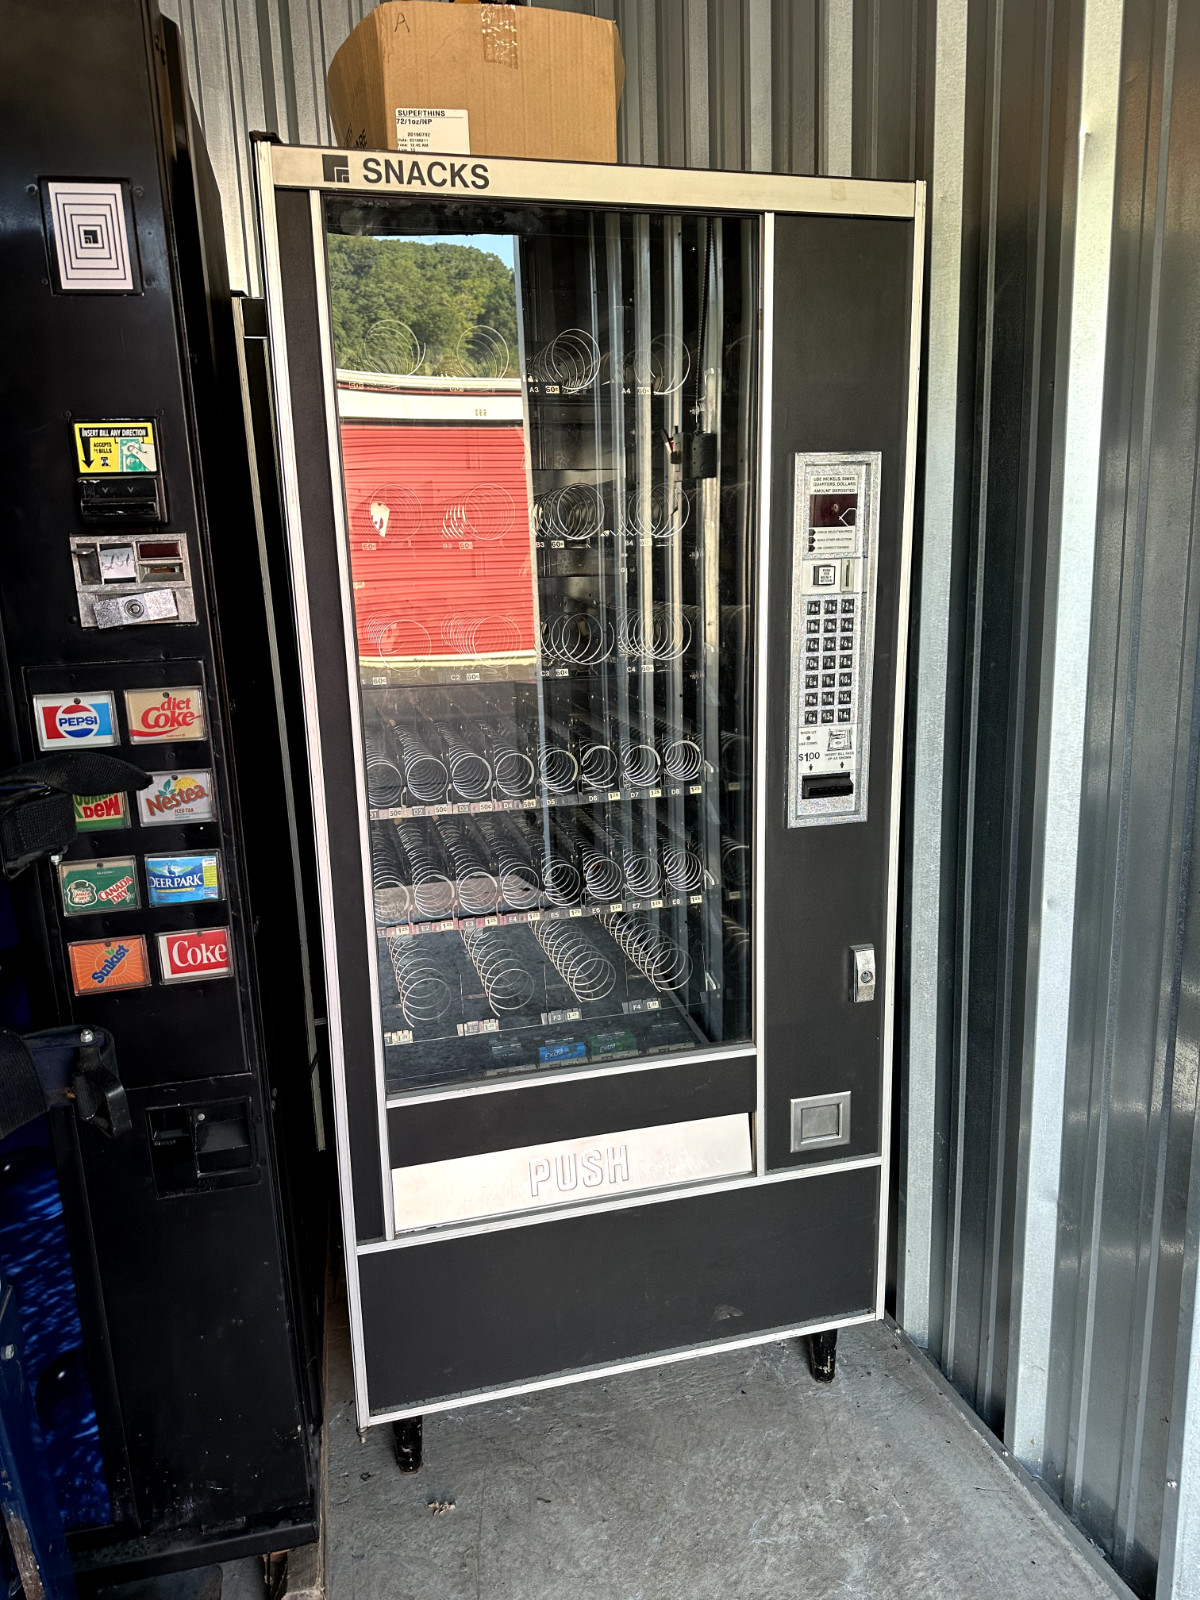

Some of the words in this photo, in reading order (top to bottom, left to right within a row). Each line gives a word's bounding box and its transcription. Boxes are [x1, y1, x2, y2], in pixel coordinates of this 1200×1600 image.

[394, 12, 410, 32] A
[362, 157, 490, 190] SNACKS
[82, 428, 98, 436] INSERT
[161, 697, 191, 711] diet
[59, 716, 98, 727] PEPSI
[141, 707, 195, 729] Coke
[146, 785, 208, 816] Nestea
[98, 876, 133, 900] CANADA
[174, 873, 203, 887] PARK
[111, 888, 129, 904] DRY
[92, 945, 129, 983] Sunkist
[173, 941, 227, 967] Coke
[528, 1145, 630, 1197] PUSH
